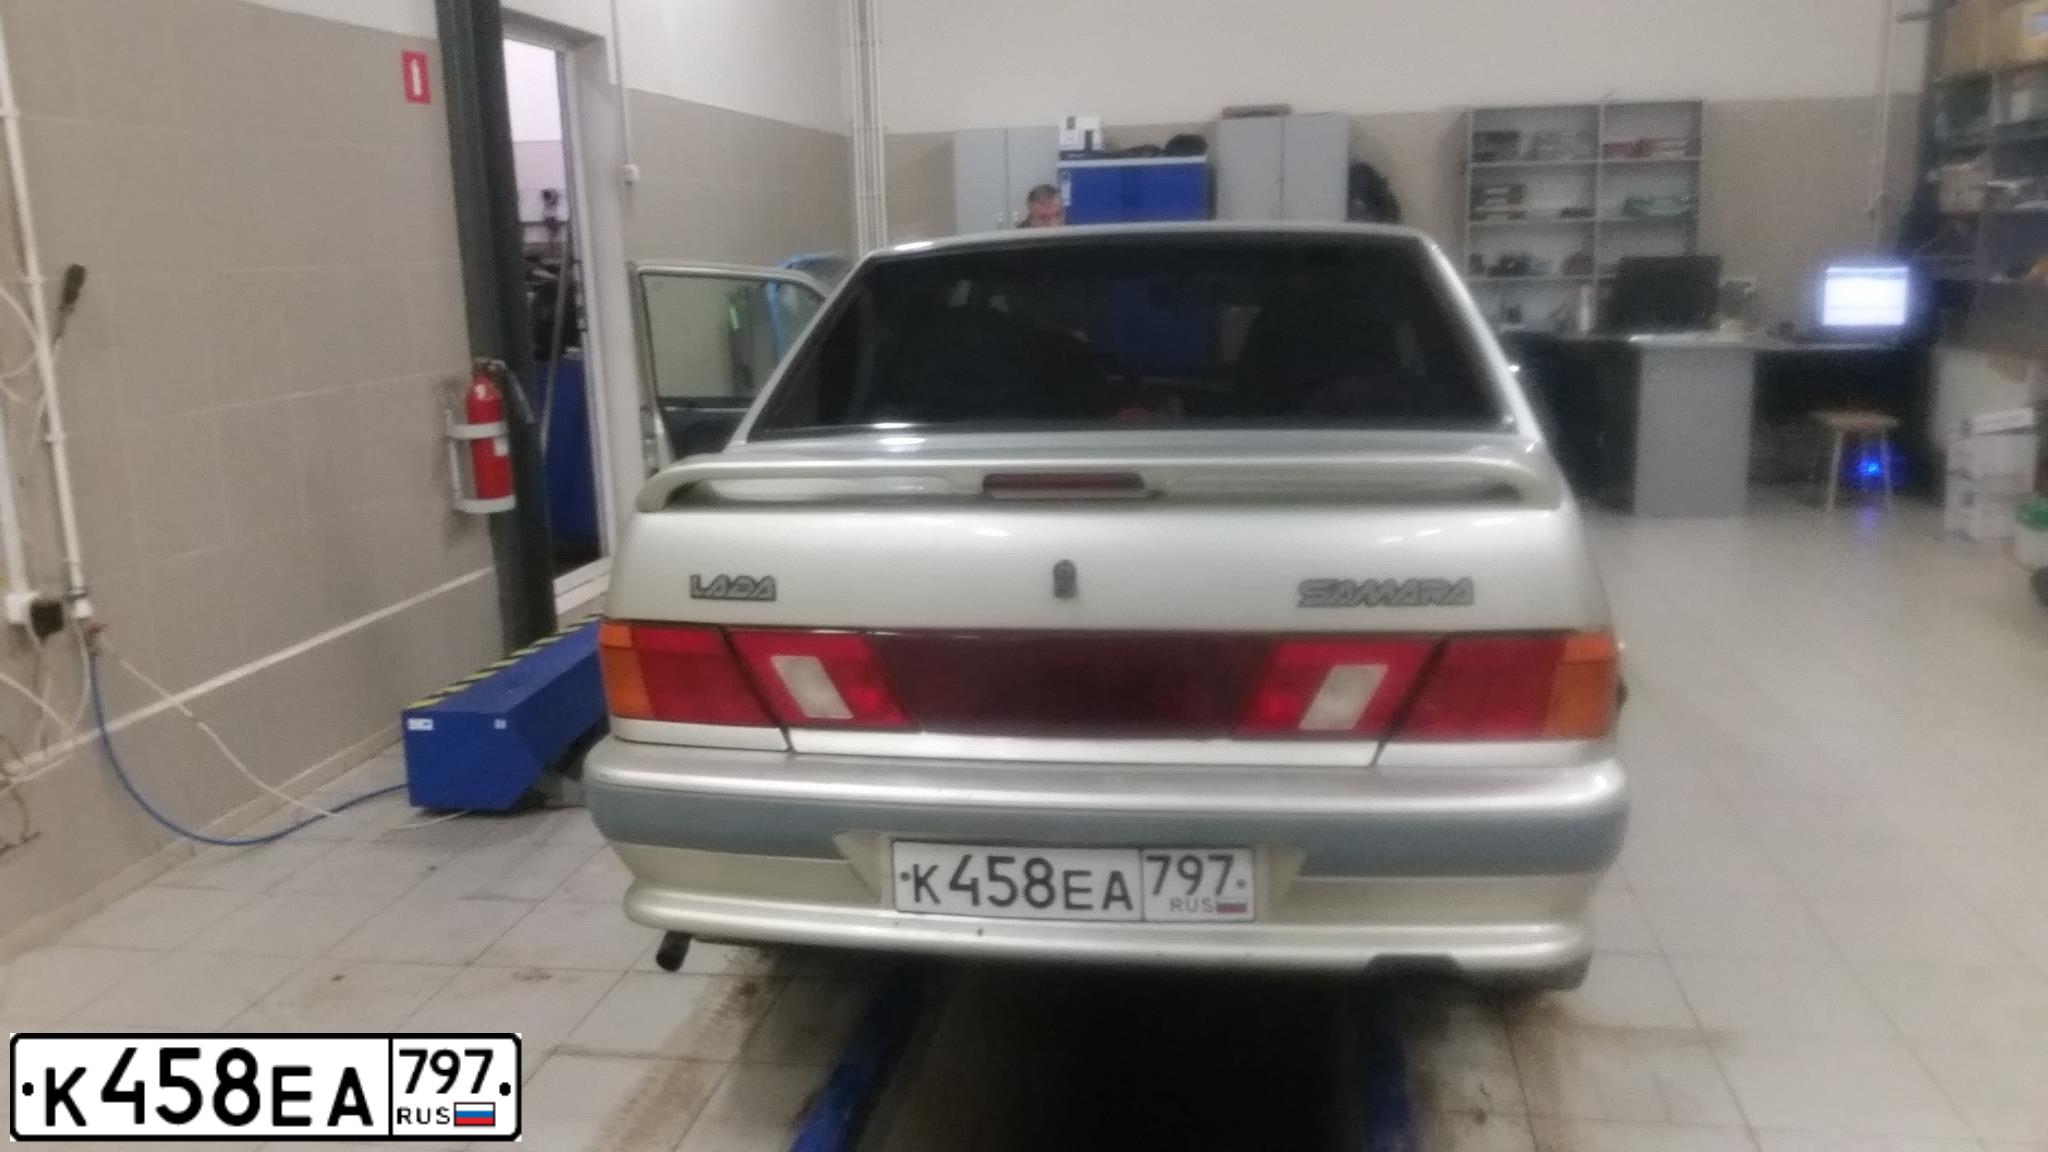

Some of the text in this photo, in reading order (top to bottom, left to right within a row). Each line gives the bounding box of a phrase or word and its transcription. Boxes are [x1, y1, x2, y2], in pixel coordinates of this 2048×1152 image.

[690, 574, 776, 601] LADA
[1298, 578, 1474, 607] SAMARA
[1146, 854, 1234, 896] 797
[1170, 898, 1214, 913] RUS
